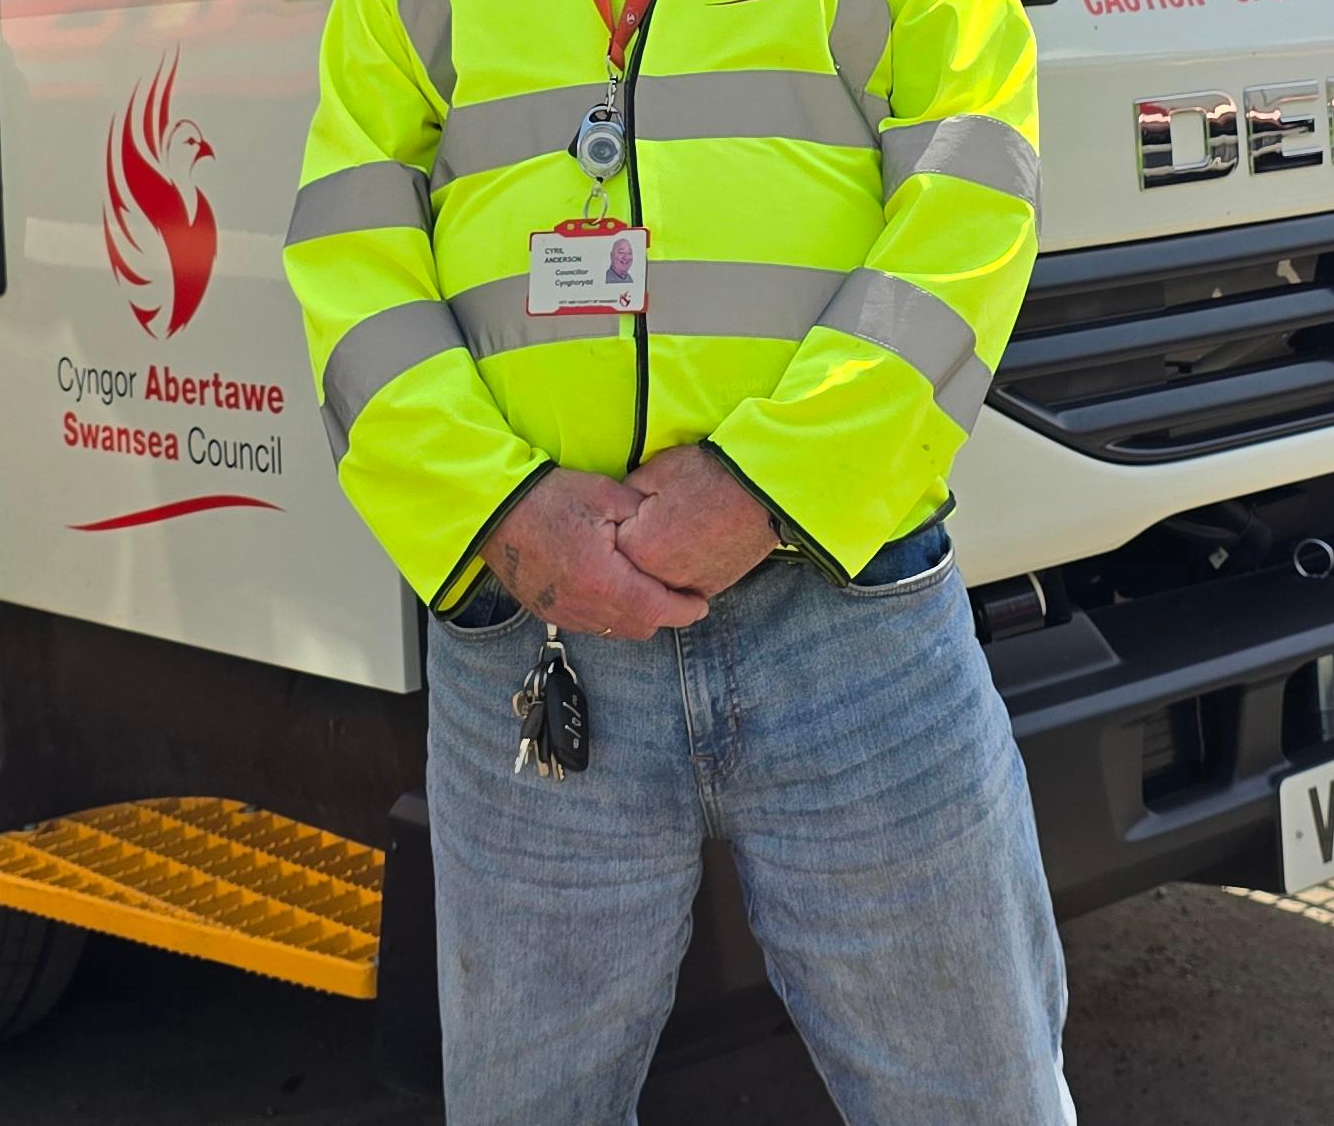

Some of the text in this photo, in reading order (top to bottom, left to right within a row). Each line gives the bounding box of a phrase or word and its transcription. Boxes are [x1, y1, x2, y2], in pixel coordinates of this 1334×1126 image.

[544, 247, 565, 255] CYRIL
[544, 256, 582, 264] ANDERSON
[58, 356, 285, 414] Cyngor Abertawe
[63, 411, 283, 475] Swansea Council
